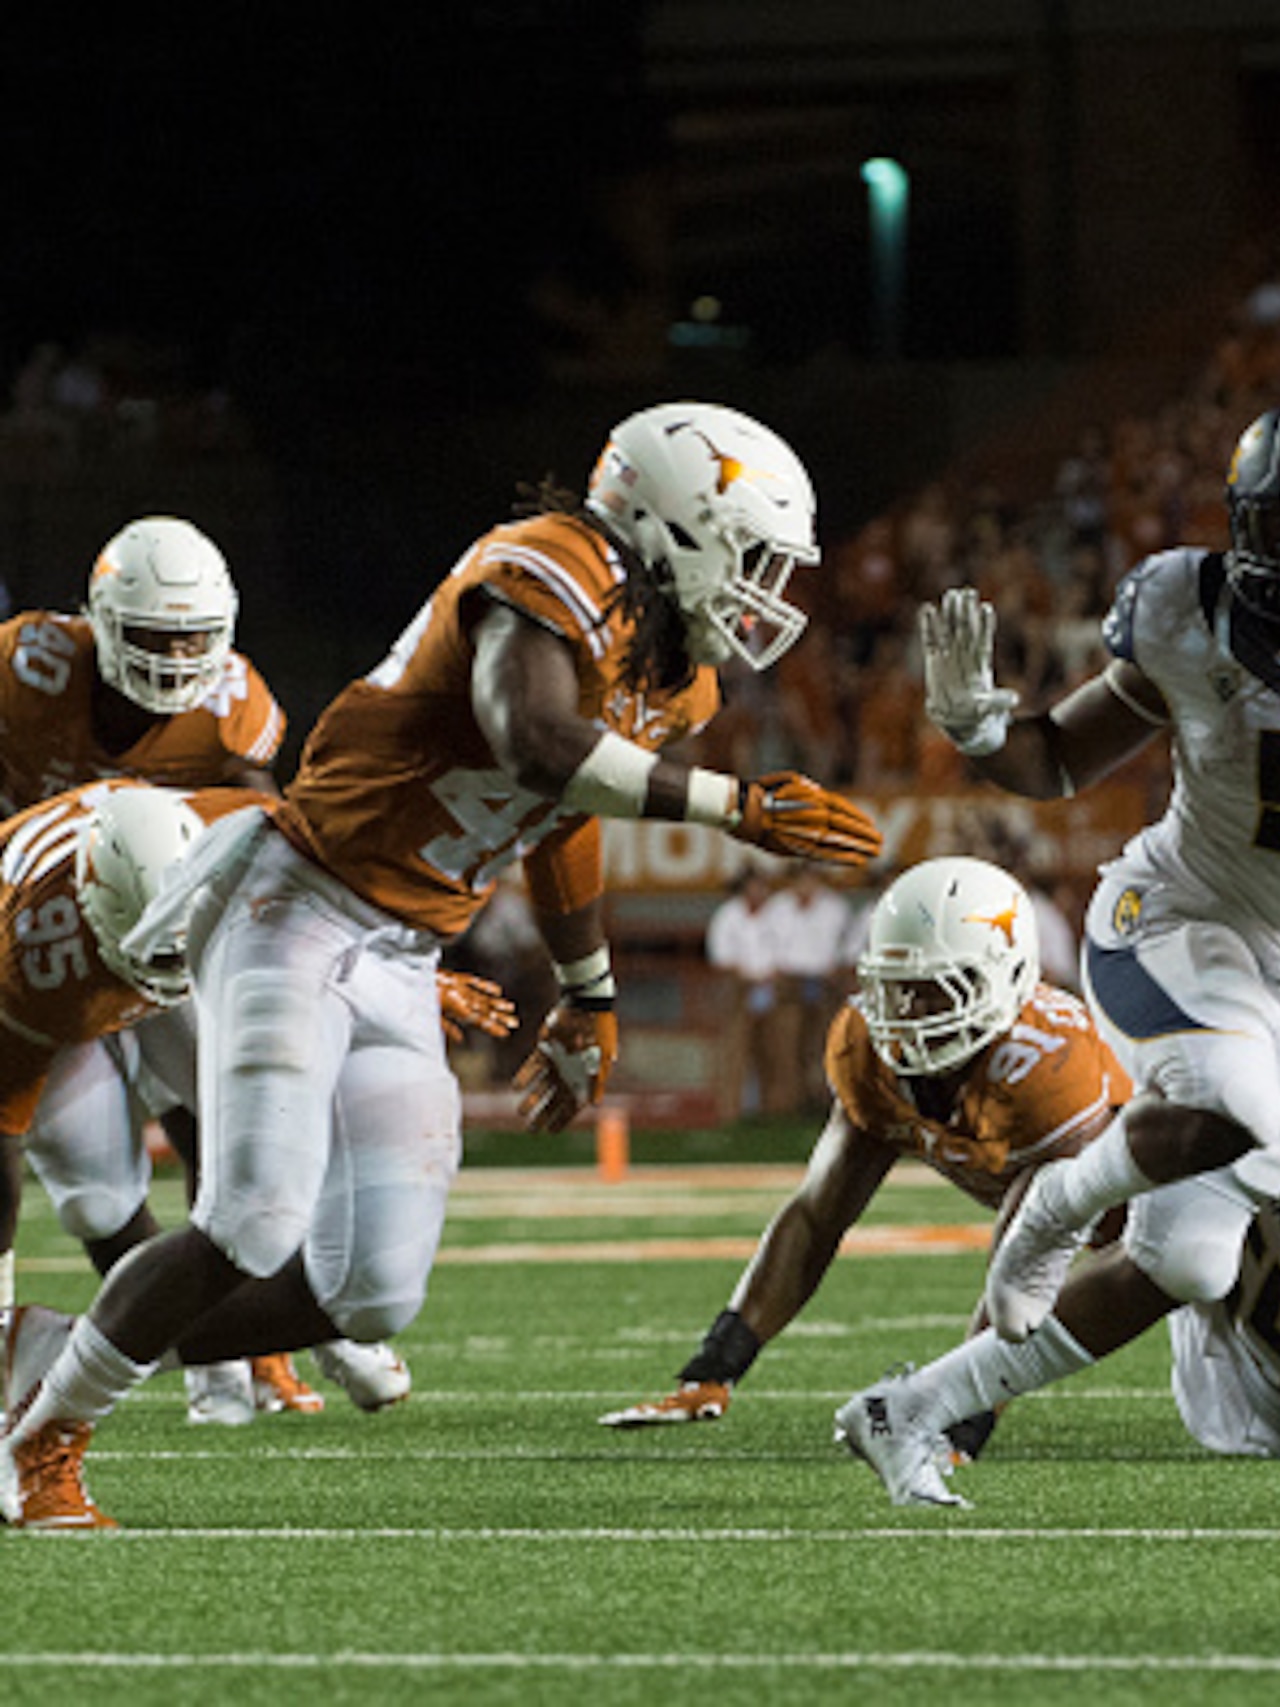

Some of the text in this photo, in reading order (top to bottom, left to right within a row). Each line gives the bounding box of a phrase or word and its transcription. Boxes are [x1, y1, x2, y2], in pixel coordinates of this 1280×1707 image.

[418, 767, 578, 894] 4
[15, 894, 90, 989] 95
[987, 1023, 1067, 1084] 91
